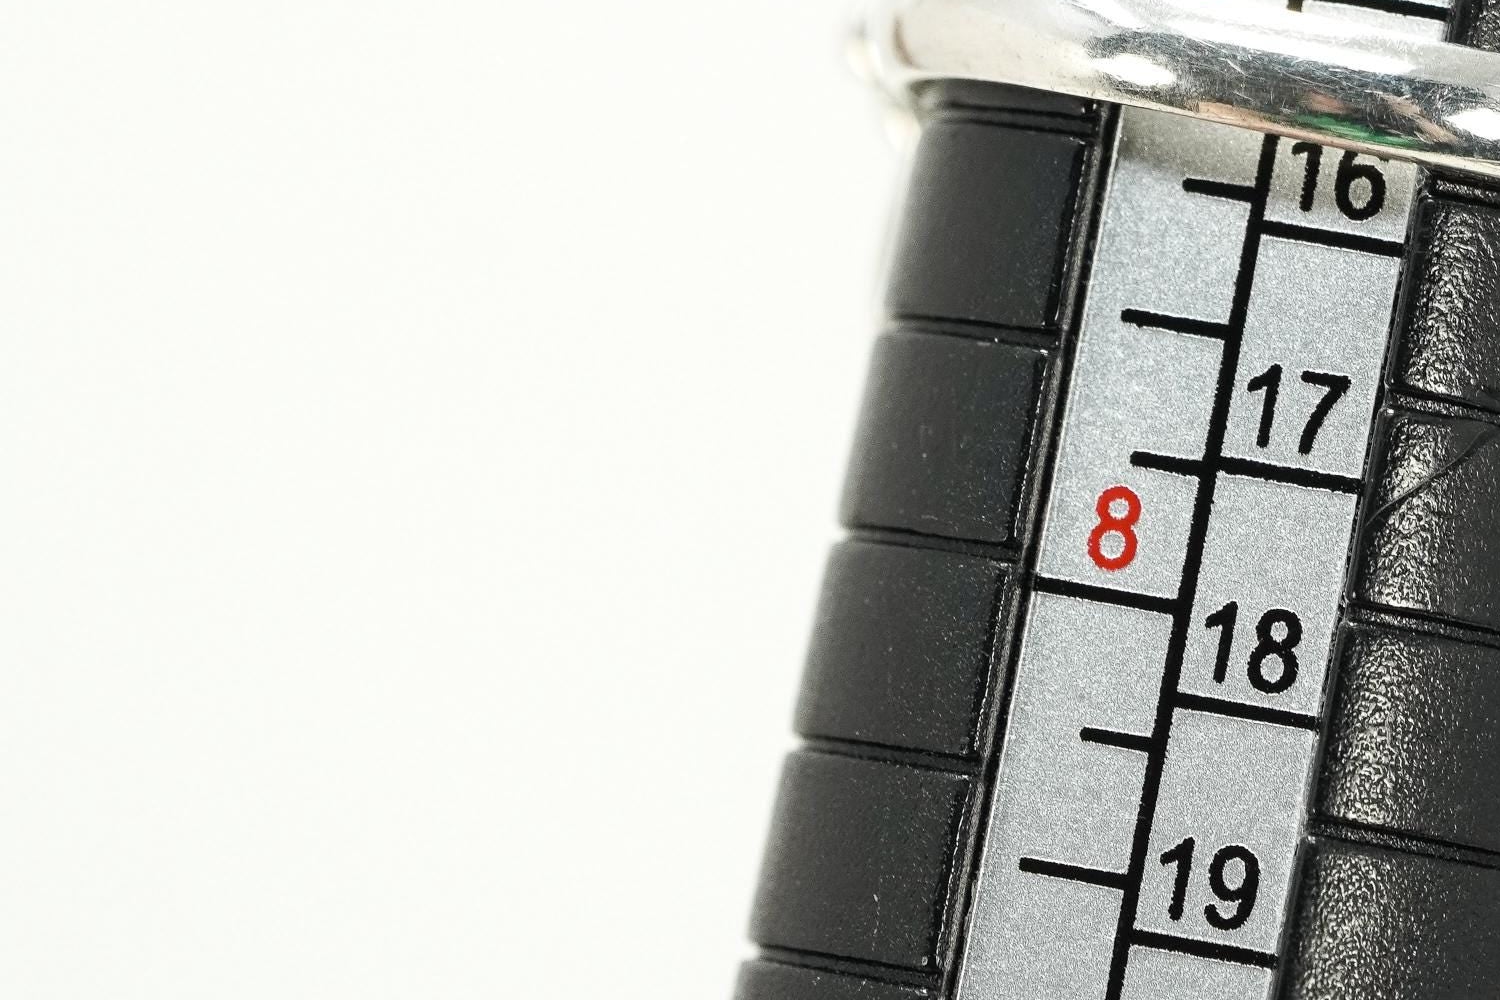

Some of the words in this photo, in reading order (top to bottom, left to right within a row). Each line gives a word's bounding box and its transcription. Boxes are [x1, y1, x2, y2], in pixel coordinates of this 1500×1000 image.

[1291, 142, 1387, 221] 16
[1246, 363, 1352, 454] 17
[1086, 486, 1142, 572] 8
[1204, 600, 1303, 695] 18
[1159, 836, 1261, 931] 19
